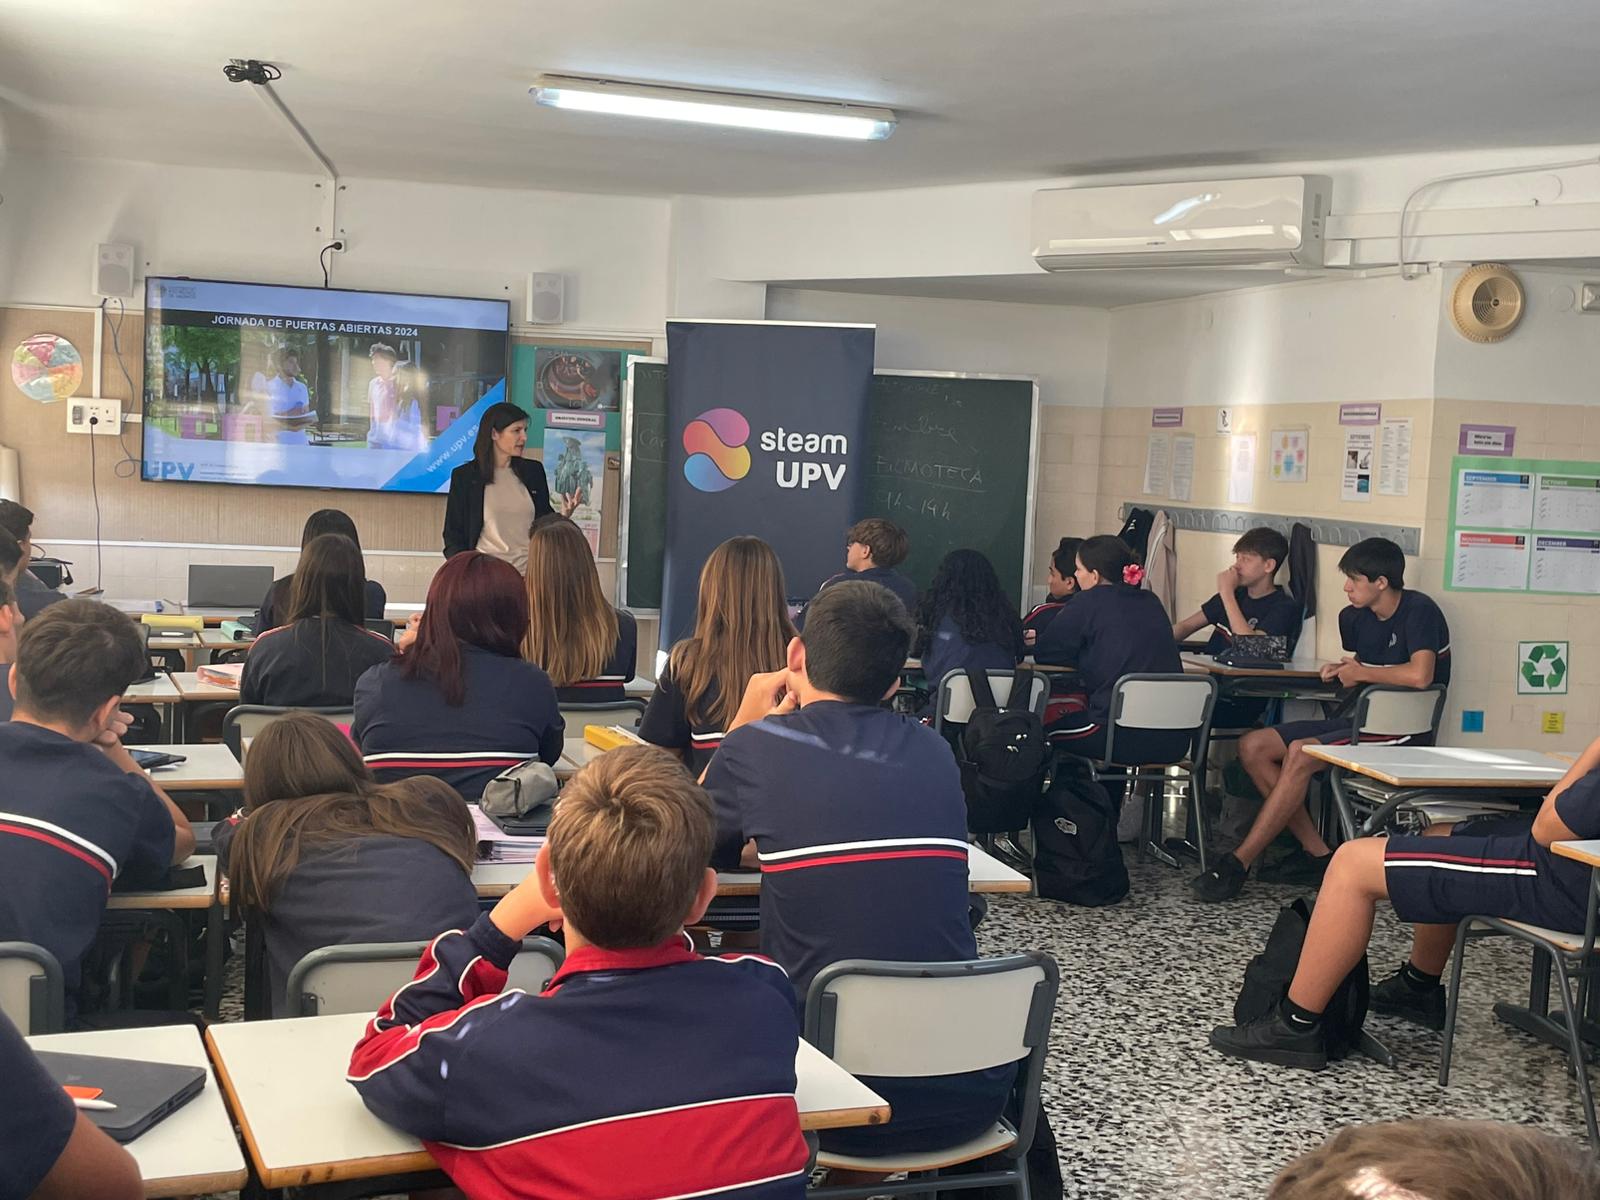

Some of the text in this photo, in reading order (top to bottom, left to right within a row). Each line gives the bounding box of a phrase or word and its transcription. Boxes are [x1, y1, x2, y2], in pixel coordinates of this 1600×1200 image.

[211, 314, 418, 337] JORNADA DE PUERTAS ABIERTAS 2024
[760, 427, 848, 455] steam
[143, 460, 195, 481] UPV
[776, 461, 847, 491] UPV
